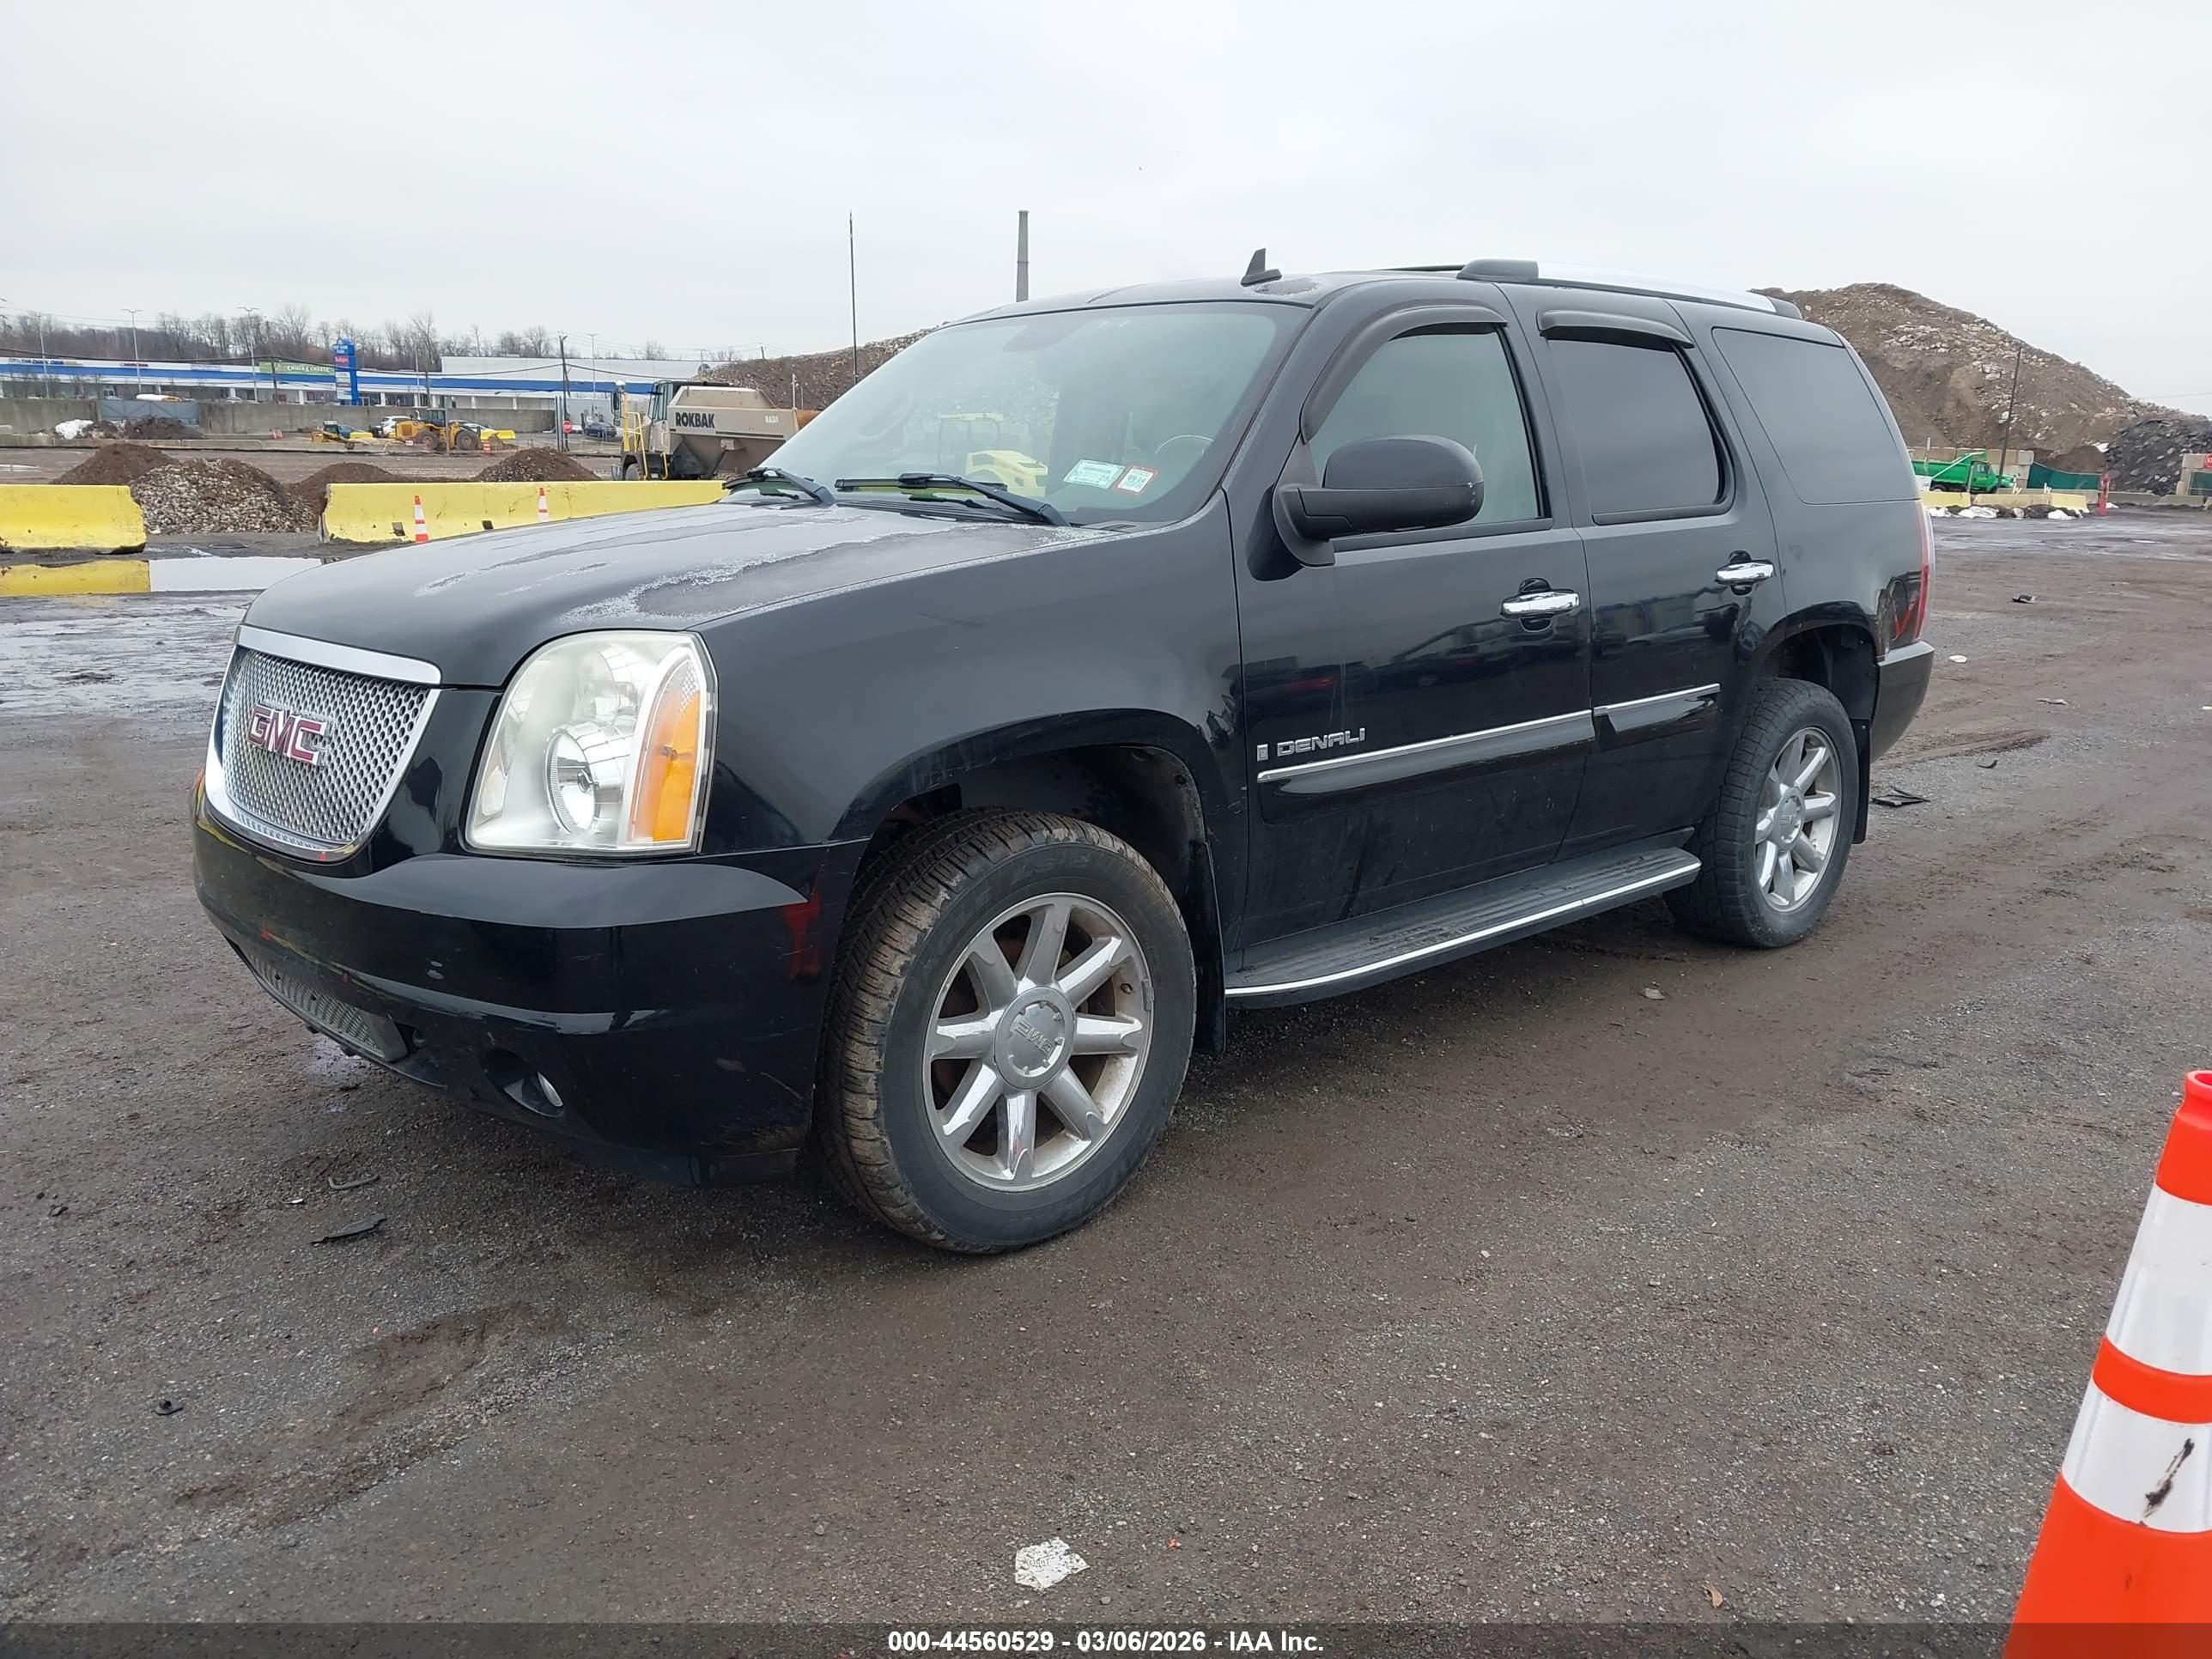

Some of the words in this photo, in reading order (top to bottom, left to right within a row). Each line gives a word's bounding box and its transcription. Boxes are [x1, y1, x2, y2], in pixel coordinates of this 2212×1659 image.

[676, 412, 715, 428] ROKBAK
[247, 702, 328, 766] GMC
[1277, 727, 1365, 757] DENALI
[1015, 1019, 1054, 1056] GMC
